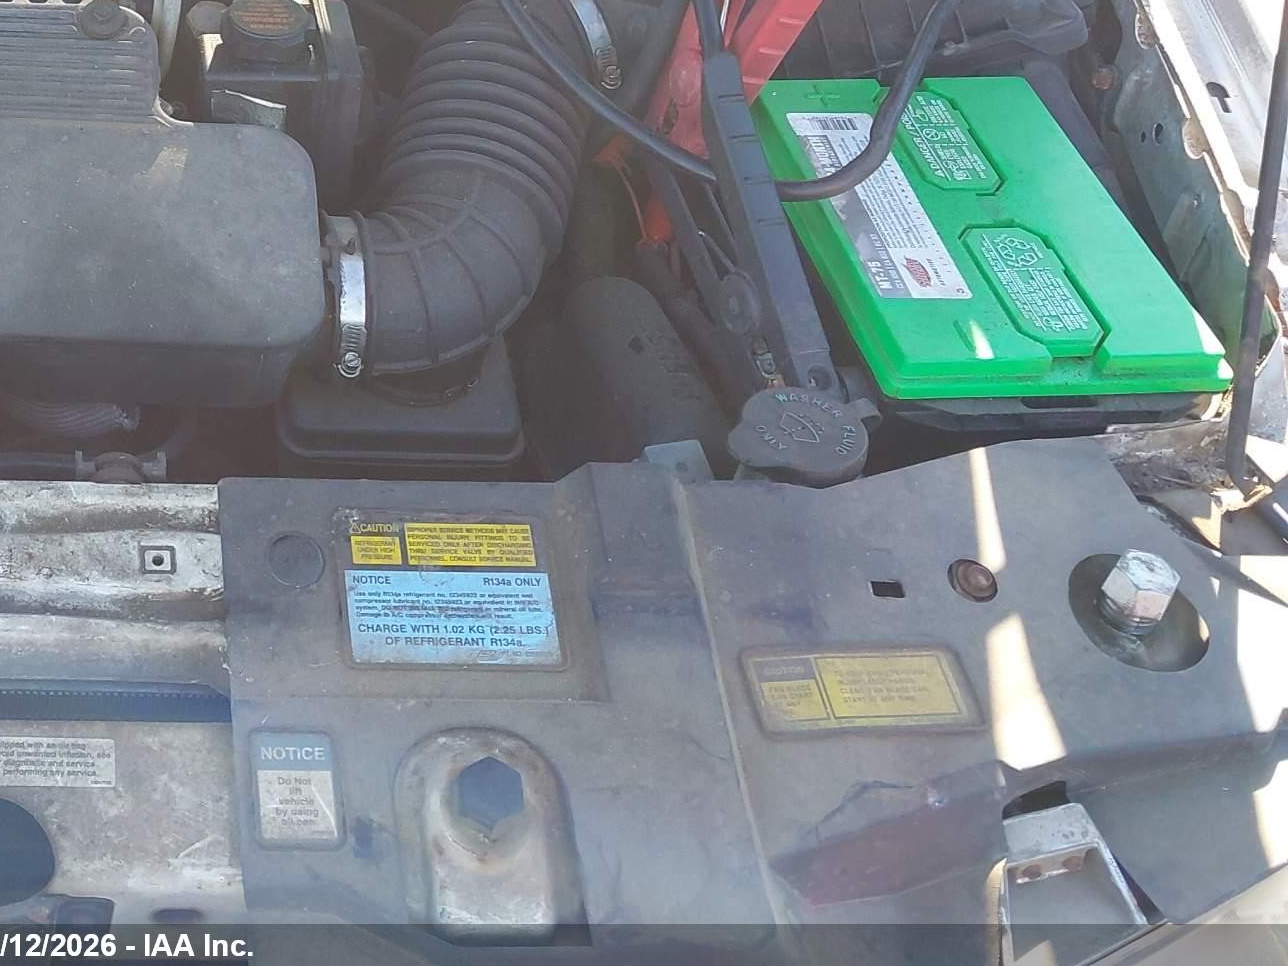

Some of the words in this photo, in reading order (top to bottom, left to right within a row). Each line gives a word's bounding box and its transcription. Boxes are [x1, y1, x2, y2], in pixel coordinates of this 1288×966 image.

[913, 137, 940, 169] DANGER
[775, 393, 844, 419] WASHER
[755, 425, 788, 450] ONLY
[834, 425, 856, 455] FLUID
[359, 523, 400, 534] CAUTION
[353, 575, 392, 585] NOTICE
[483, 577, 512, 587] R134a
[515, 578, 541, 587] ONLY
[358, 624, 406, 634] CHARGE
[410, 624, 440, 634] WITH
[443, 625, 464, 634] 1.02
[468, 625, 485, 634] KG
[490, 626, 516, 635] (2.25
[386, 637, 401, 646] OF
[405, 637, 486, 647] REFRIGERANT
[260, 746, 326, 761] NOTICE
[3, 760, 45, 768] diagnostic
[66, 760, 95, 768] service
[3, 767, 48, 777] performing
[49, 769, 64, 778] any
[277, 776, 291, 786] Do
[294, 777, 312, 786] Not
[278, 796, 315, 806] vehicle
[275, 808, 288, 818] by
[290, 809, 320, 818] using
